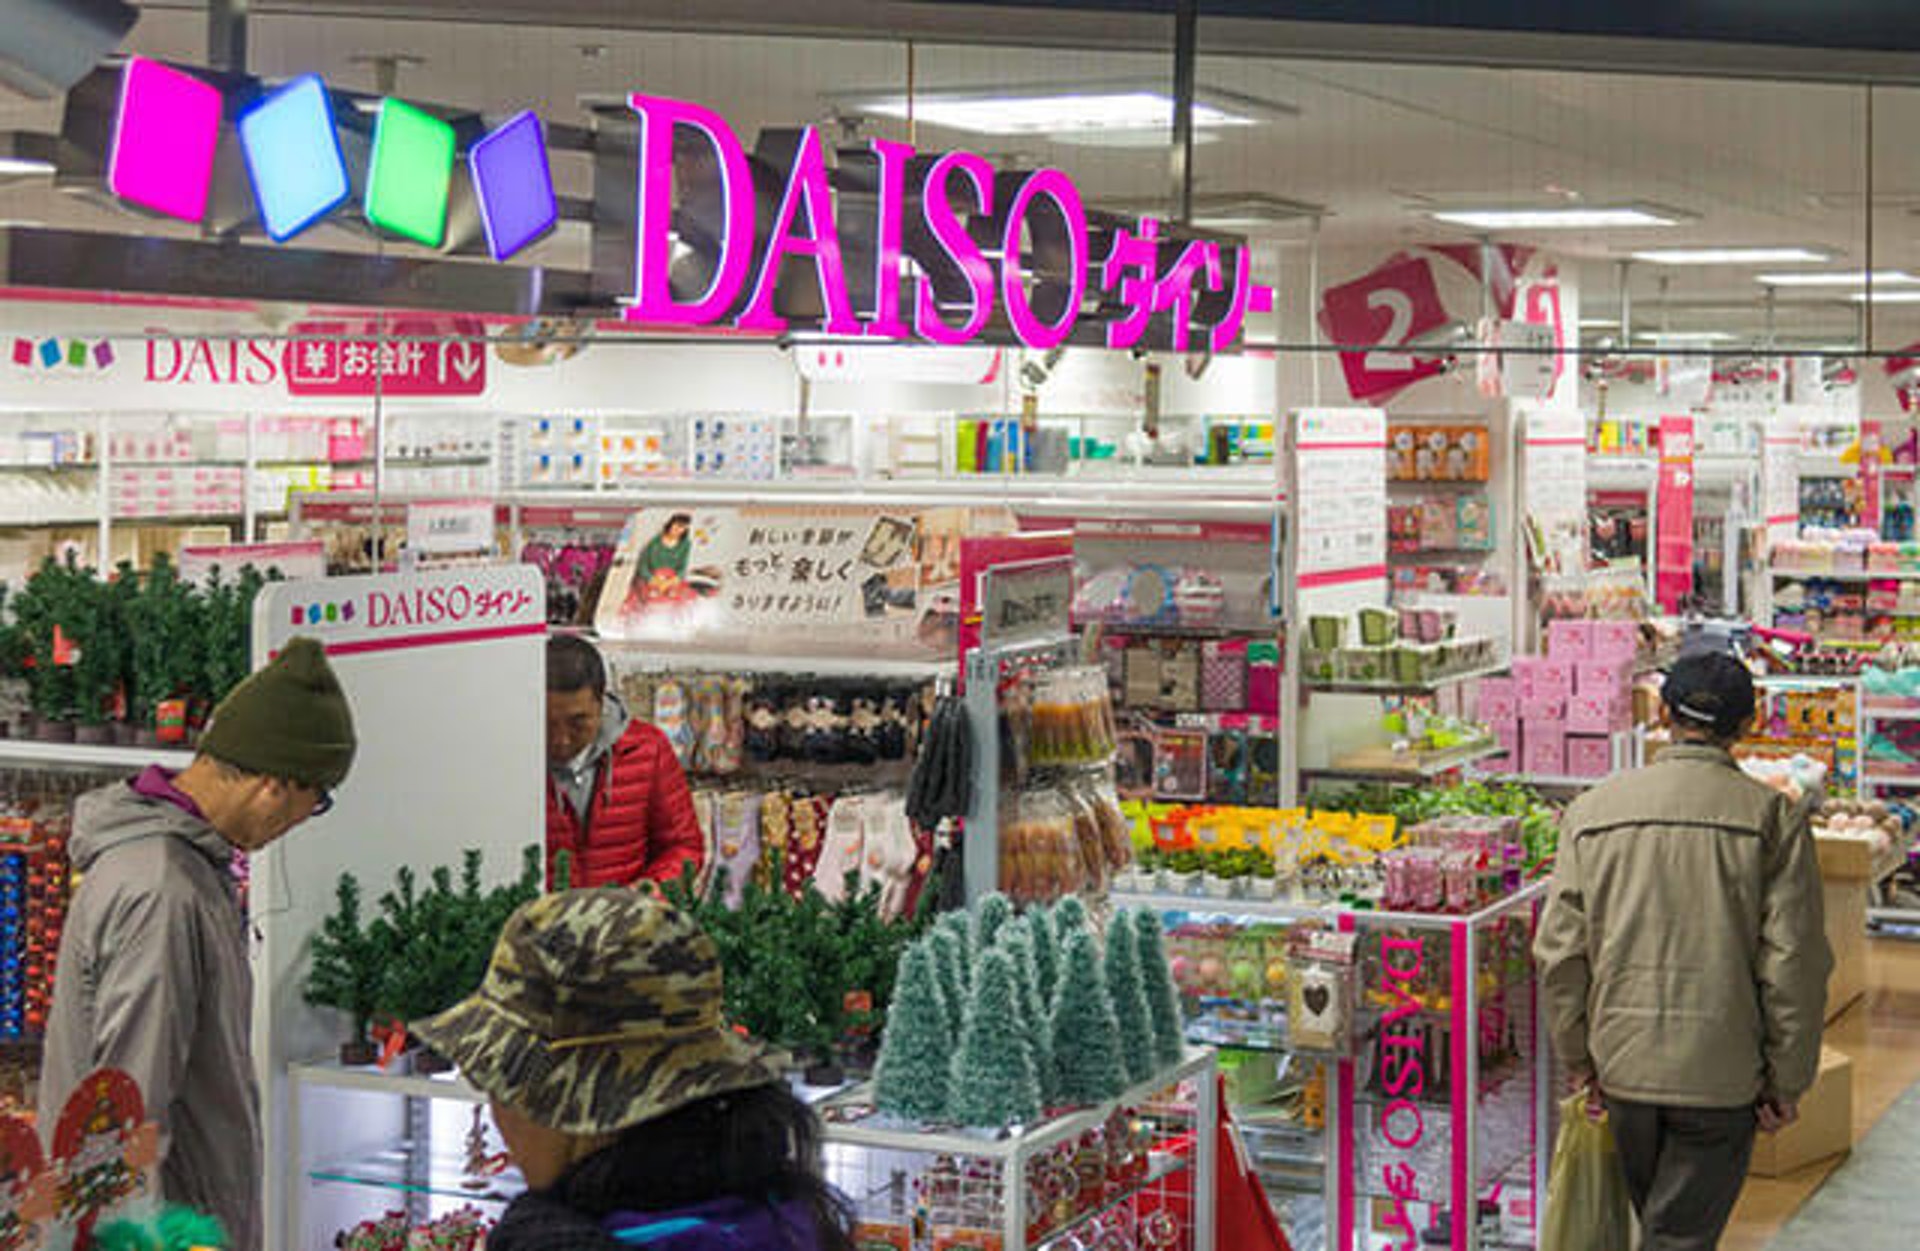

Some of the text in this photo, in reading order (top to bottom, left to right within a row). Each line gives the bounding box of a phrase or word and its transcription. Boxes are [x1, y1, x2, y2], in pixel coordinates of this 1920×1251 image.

[621, 92, 1273, 353] DAISO ダイソー
[144, 328, 289, 384] DAIS
[343, 342, 427, 377] お会計
[1364, 287, 1414, 371] 2
[366, 583, 532, 628] DAISO ダイソー
[1380, 934, 1425, 1149] DAISO
